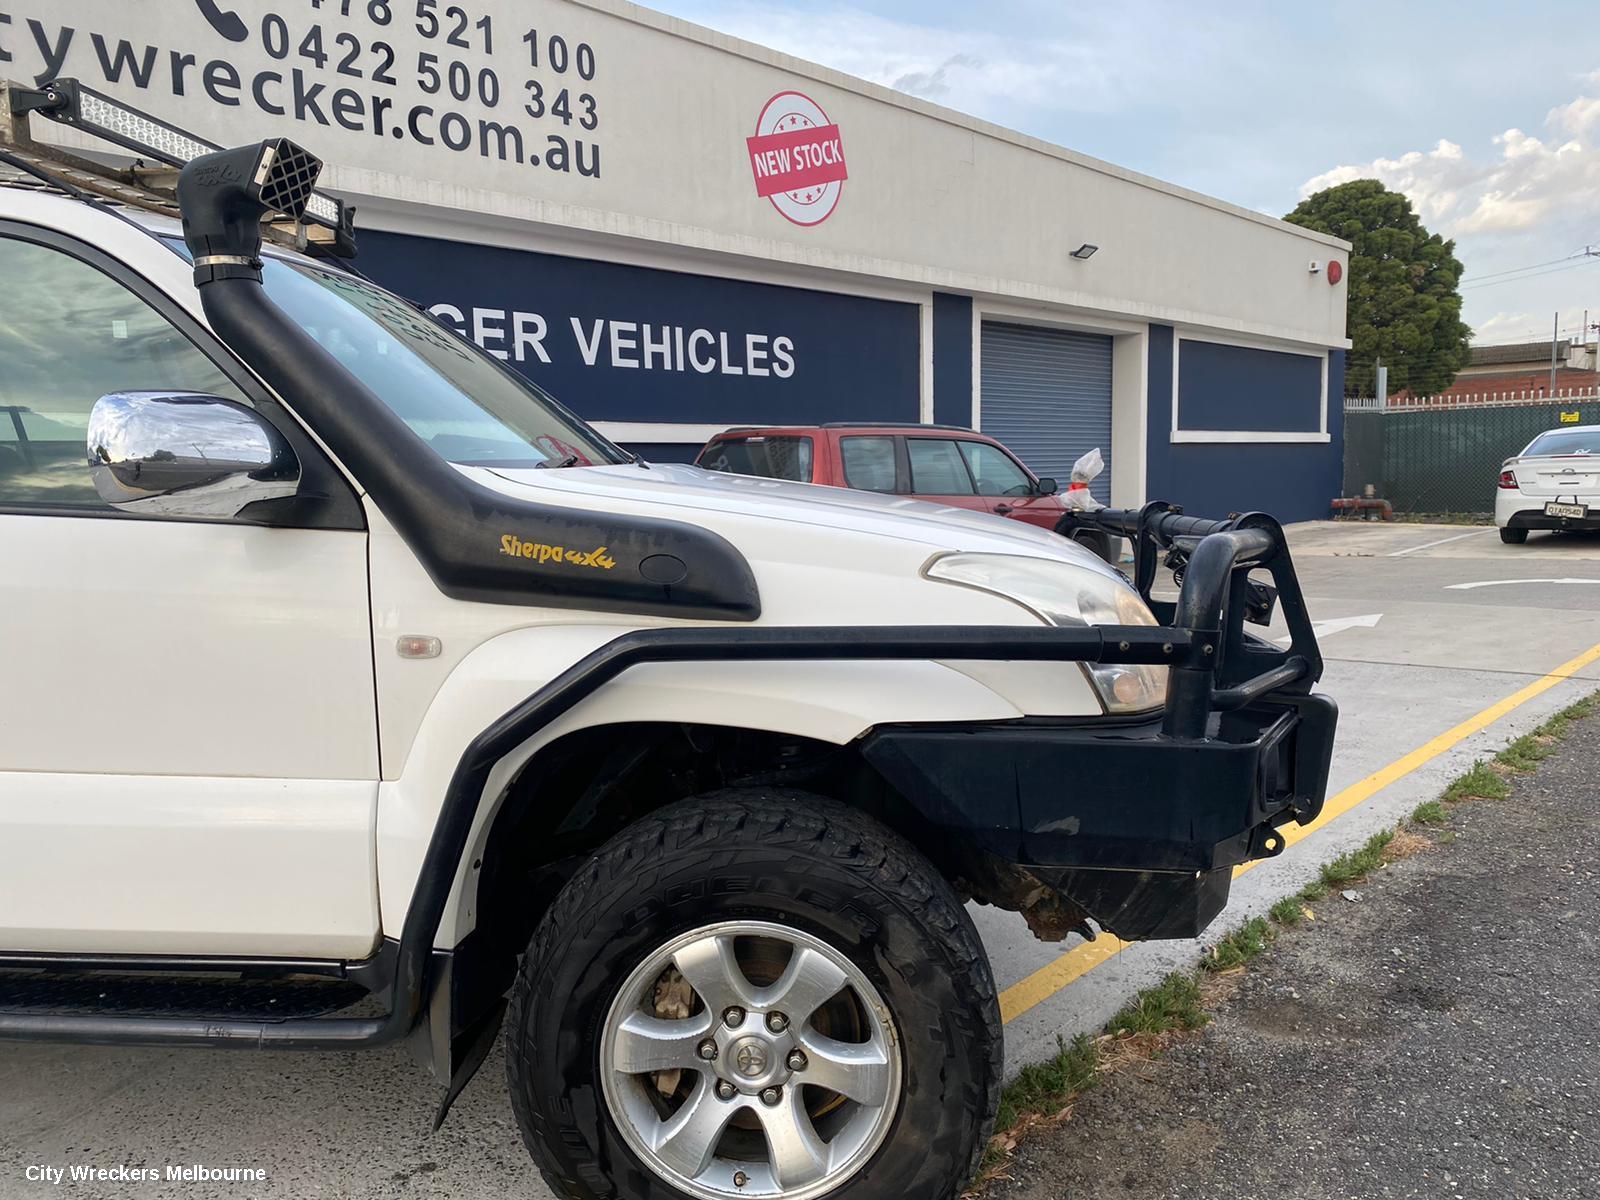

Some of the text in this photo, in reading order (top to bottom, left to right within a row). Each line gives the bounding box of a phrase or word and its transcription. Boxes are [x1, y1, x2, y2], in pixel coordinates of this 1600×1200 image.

[416, 0, 493, 54] 521
[523, 29, 596, 81] 100
[262, 13, 397, 86] 0422
[417, 52, 499, 108] 500
[525, 80, 599, 131] 343
[754, 139, 842, 178] NEW STOCK
[570, 317, 795, 378] VEHICLES
[501, 534, 563, 564] Sherpa
